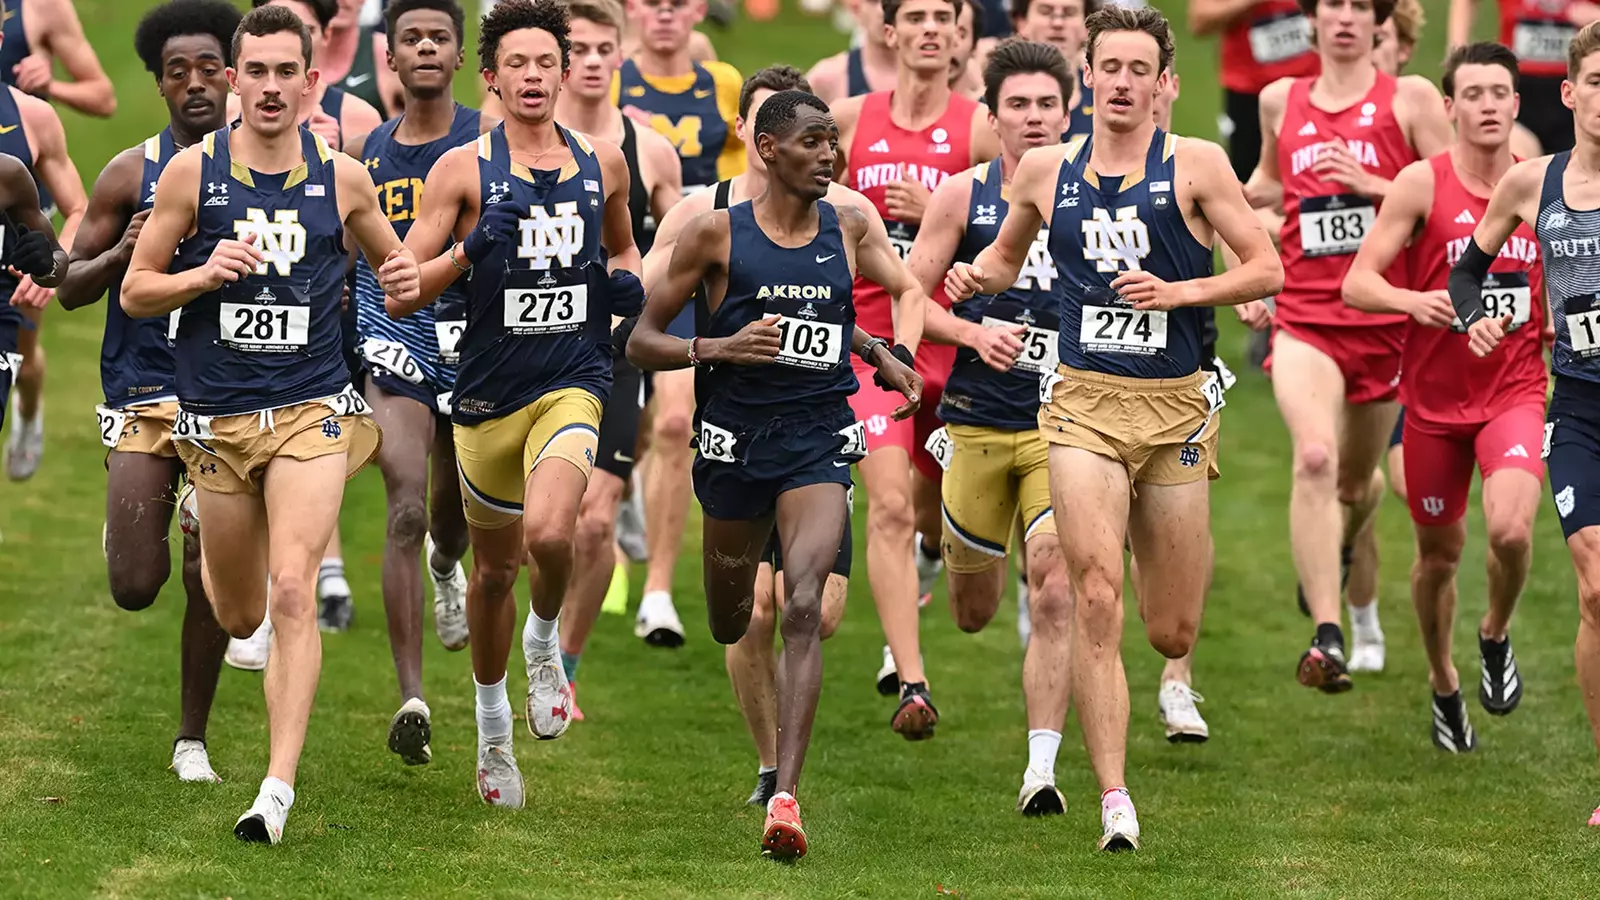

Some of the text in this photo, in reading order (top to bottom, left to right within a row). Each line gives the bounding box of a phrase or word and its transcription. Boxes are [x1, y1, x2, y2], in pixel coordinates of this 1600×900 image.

[204, 195, 229, 206] ACC
[485, 194, 504, 204] AC
[1056, 196, 1080, 209] ACC
[517, 201, 585, 270] ND
[1081, 204, 1152, 273] ND
[1314, 213, 1364, 242] 183
[1446, 235, 1537, 267] INANA
[518, 290, 574, 323] 273
[756, 285, 832, 300] AKRON
[234, 307, 289, 341] 281
[777, 320, 830, 358] 103
[1094, 310, 1153, 342] 274
[1579, 314, 1600, 345] 1
[372, 345, 416, 377] 216
